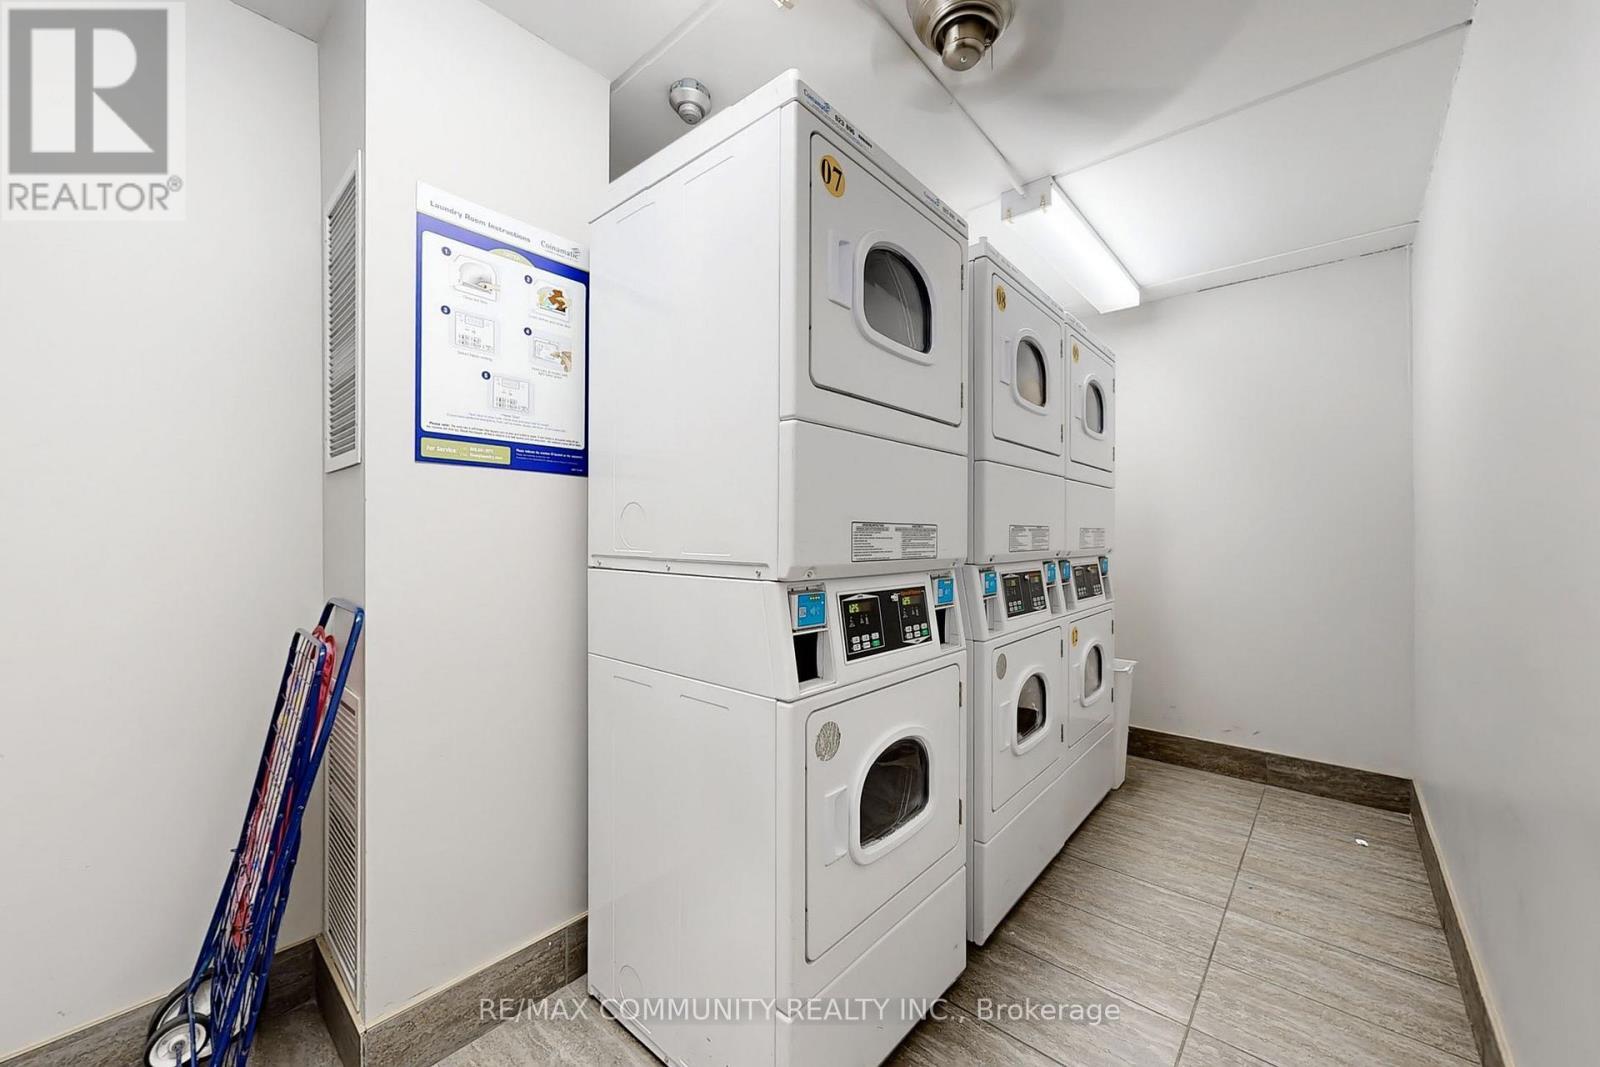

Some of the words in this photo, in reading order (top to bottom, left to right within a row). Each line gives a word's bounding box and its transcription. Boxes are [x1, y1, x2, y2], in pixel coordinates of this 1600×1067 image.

[821, 158, 843, 193] 07
[430, 200, 462, 218] Laundry
[465, 213, 486, 227] Room
[488, 221, 531, 242] Instructions
[541, 240, 580, 259] Coinamatic
